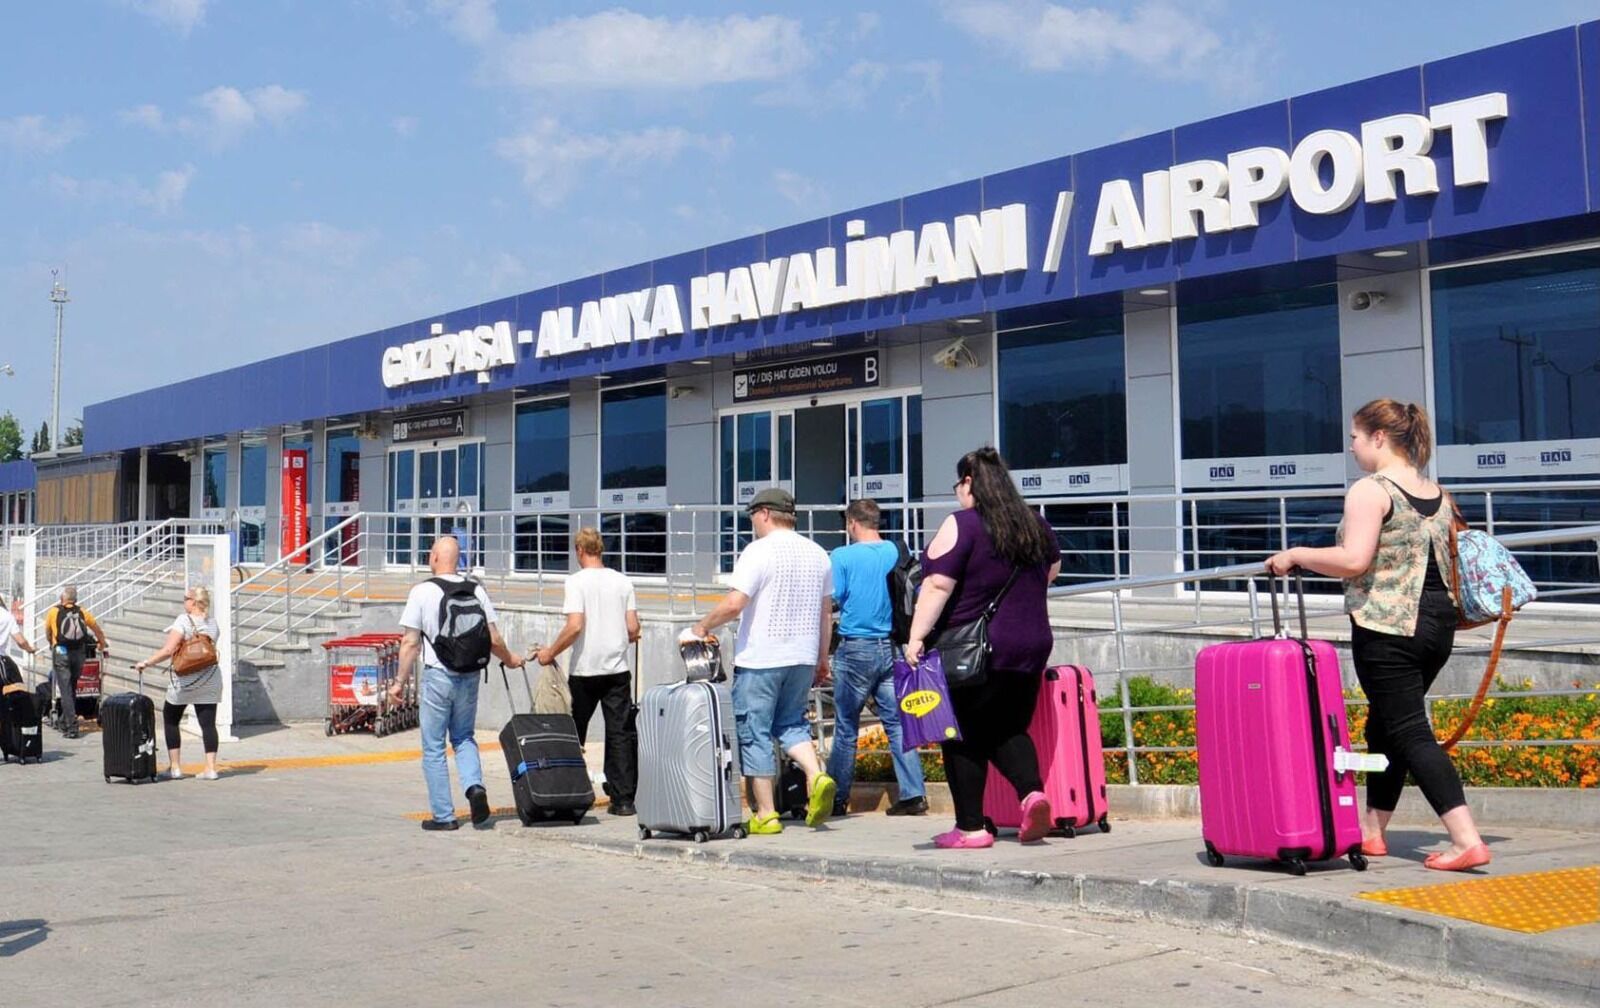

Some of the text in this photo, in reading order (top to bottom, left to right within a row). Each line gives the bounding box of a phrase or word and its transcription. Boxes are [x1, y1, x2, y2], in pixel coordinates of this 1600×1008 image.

[382, 323, 516, 389] GAZİPAŞA
[535, 284, 684, 358] ALANYA
[691, 203, 1028, 330] HAVALİMANI
[1088, 92, 1508, 256] AIRPORT
[773, 369, 787, 381] HAT
[812, 362, 838, 376] YOLCU
[865, 356, 878, 383] B
[455, 415, 464, 433] A
[1477, 454, 1506, 465] TAV
[1541, 451, 1571, 462] TAV
[1210, 467, 1235, 477] TAV
[1270, 464, 1296, 475] TAV
[905, 693, 936, 711] gratis
